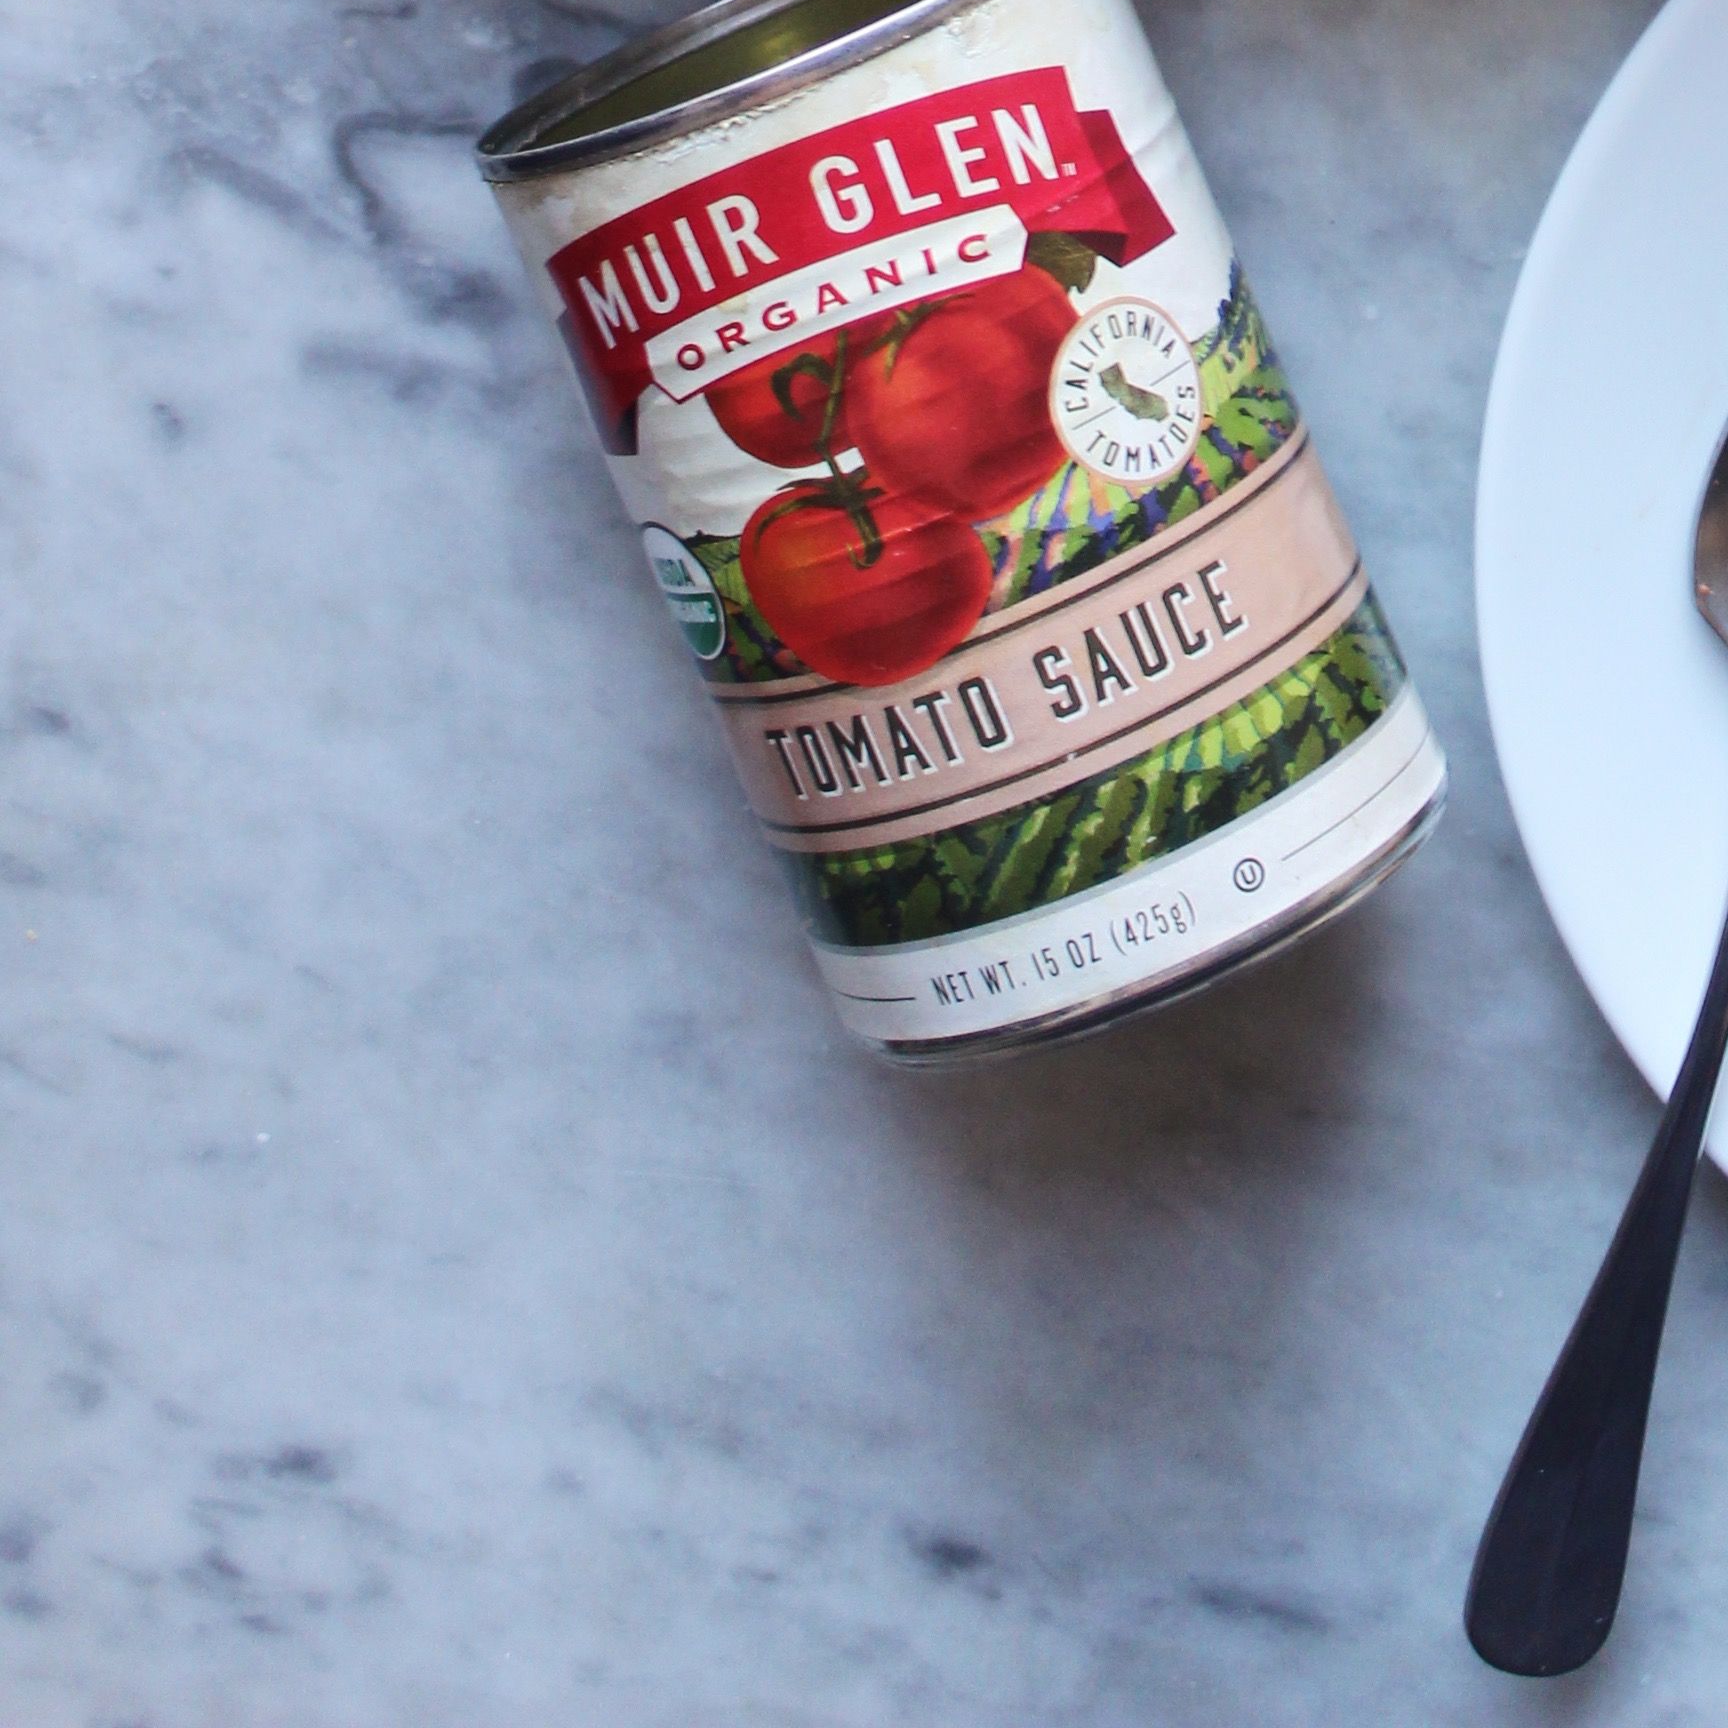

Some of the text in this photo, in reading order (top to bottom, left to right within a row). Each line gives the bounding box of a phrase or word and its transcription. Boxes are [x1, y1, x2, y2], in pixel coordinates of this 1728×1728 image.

[578, 193, 780, 350] MUIR
[807, 103, 1060, 235] GLEN
[676, 233, 991, 372] ORGANIC
[1064, 310, 1176, 413] CALIFORNIA
[1086, 385, 1196, 473] TOMATOES
[765, 559, 1249, 801] TOMATO SAUCE
[930, 890, 1197, 1006] NET WT. 15 OZ (425g)
